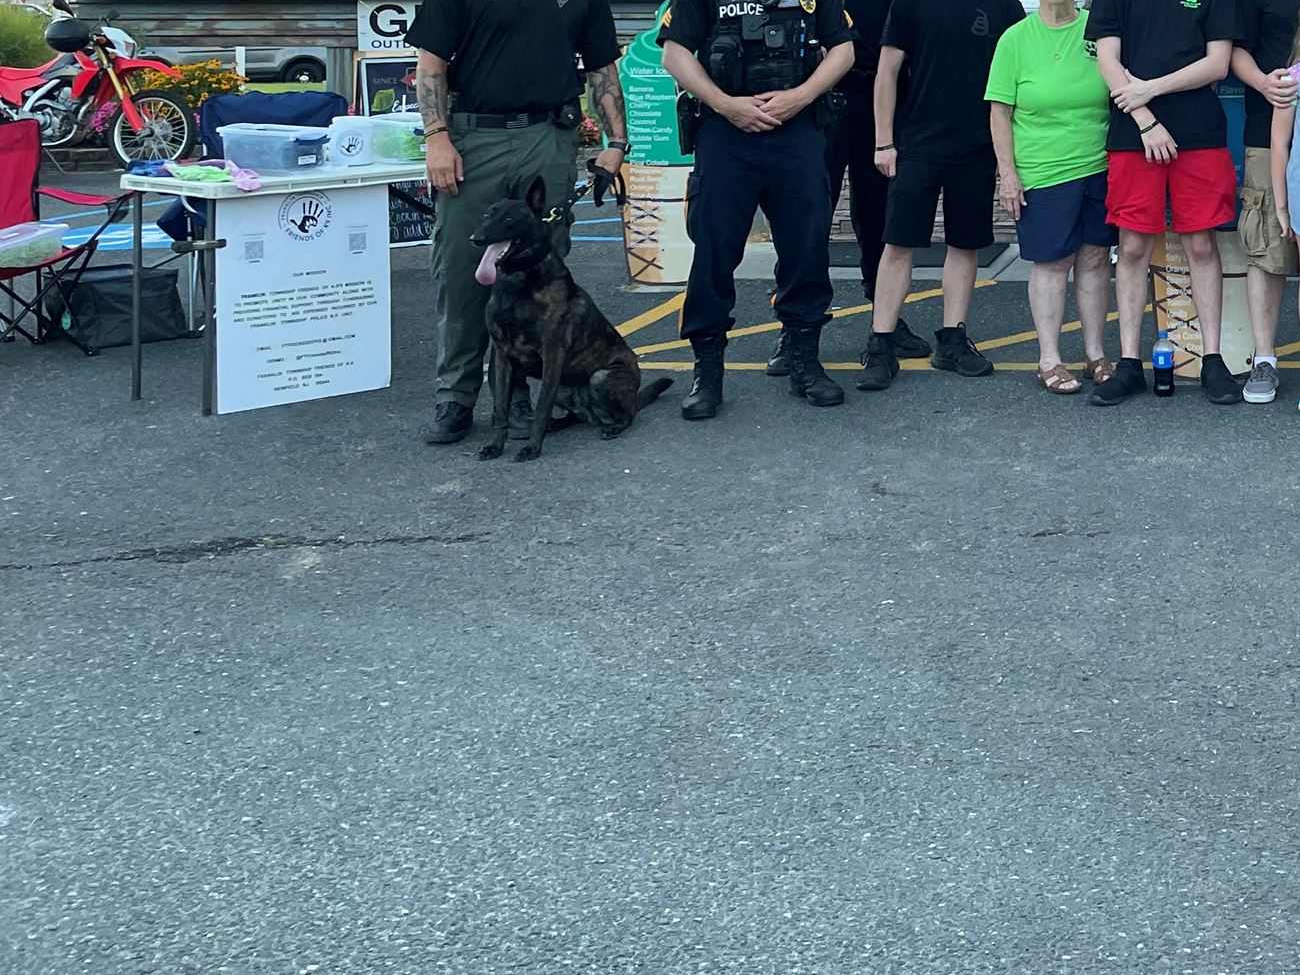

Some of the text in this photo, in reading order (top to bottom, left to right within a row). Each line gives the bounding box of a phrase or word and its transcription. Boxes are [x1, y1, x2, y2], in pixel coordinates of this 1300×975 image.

[719, 3, 764, 18] POLICE
[630, 67, 653, 75] Water
[373, 77, 398, 85] SINCE
[285, 228, 314, 241] FRIENDS
